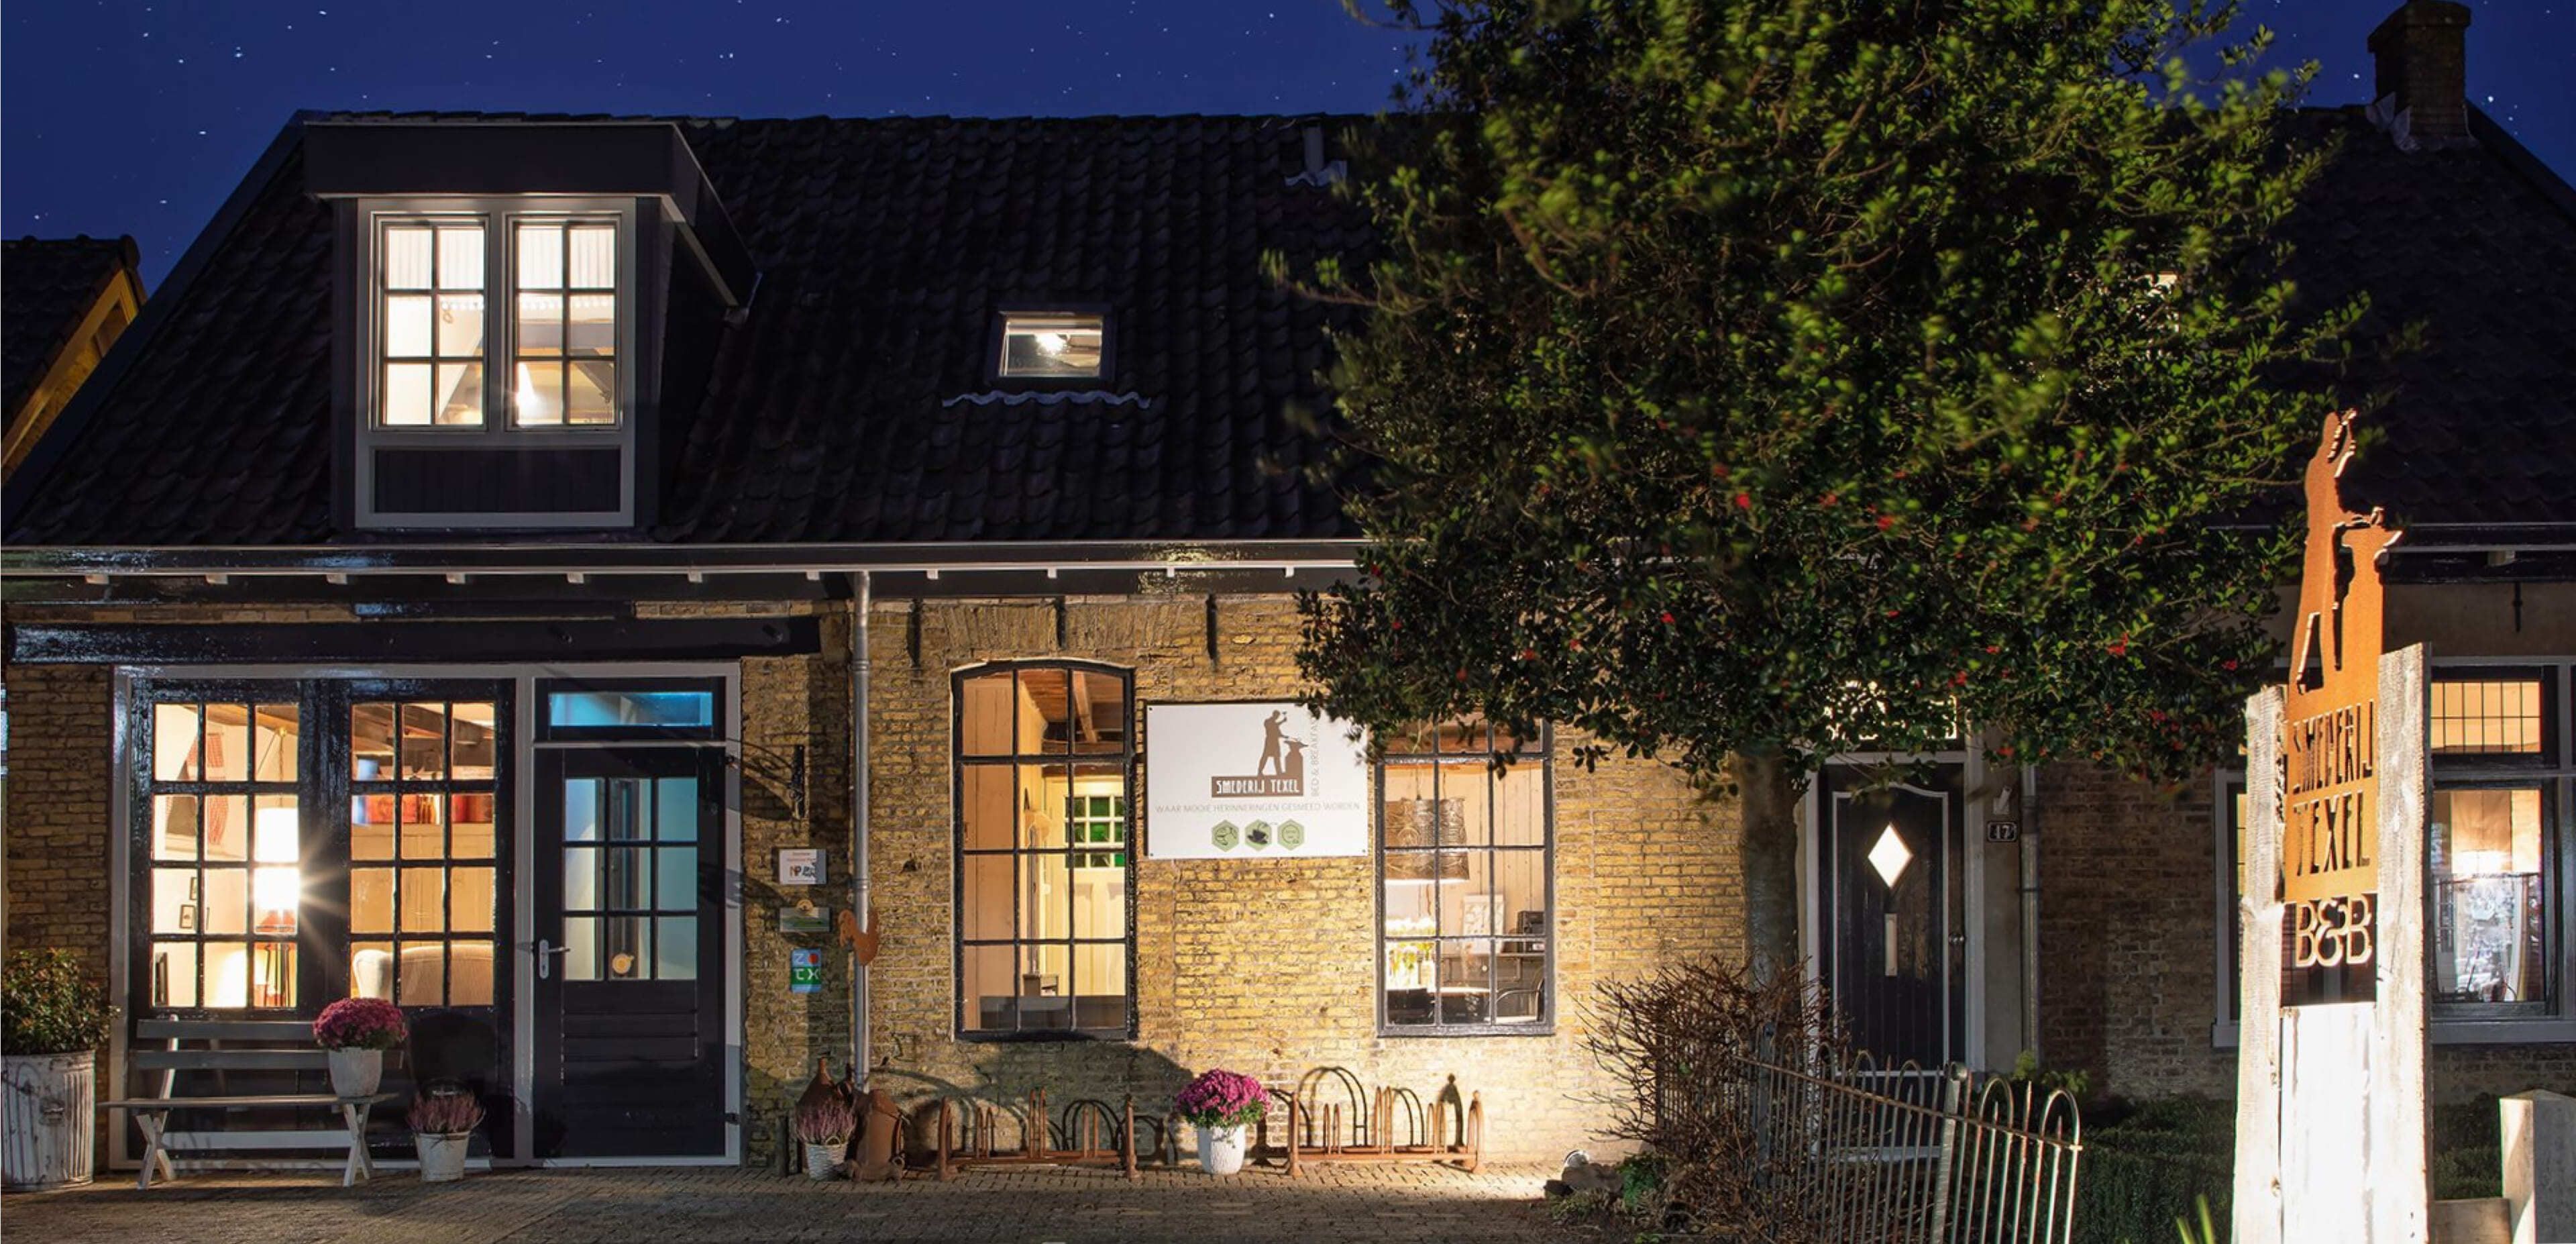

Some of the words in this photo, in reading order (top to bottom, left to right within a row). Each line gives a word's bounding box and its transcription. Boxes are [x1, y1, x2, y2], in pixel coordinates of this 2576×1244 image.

[1216, 780, 1265, 794] SMEDERIJ
[1270, 778, 1299, 794] TEXEL
[2292, 698, 2373, 794] SMEDERIJ
[2293, 790, 2371, 877] TEXEL
[2295, 895, 2373, 968] B&B
